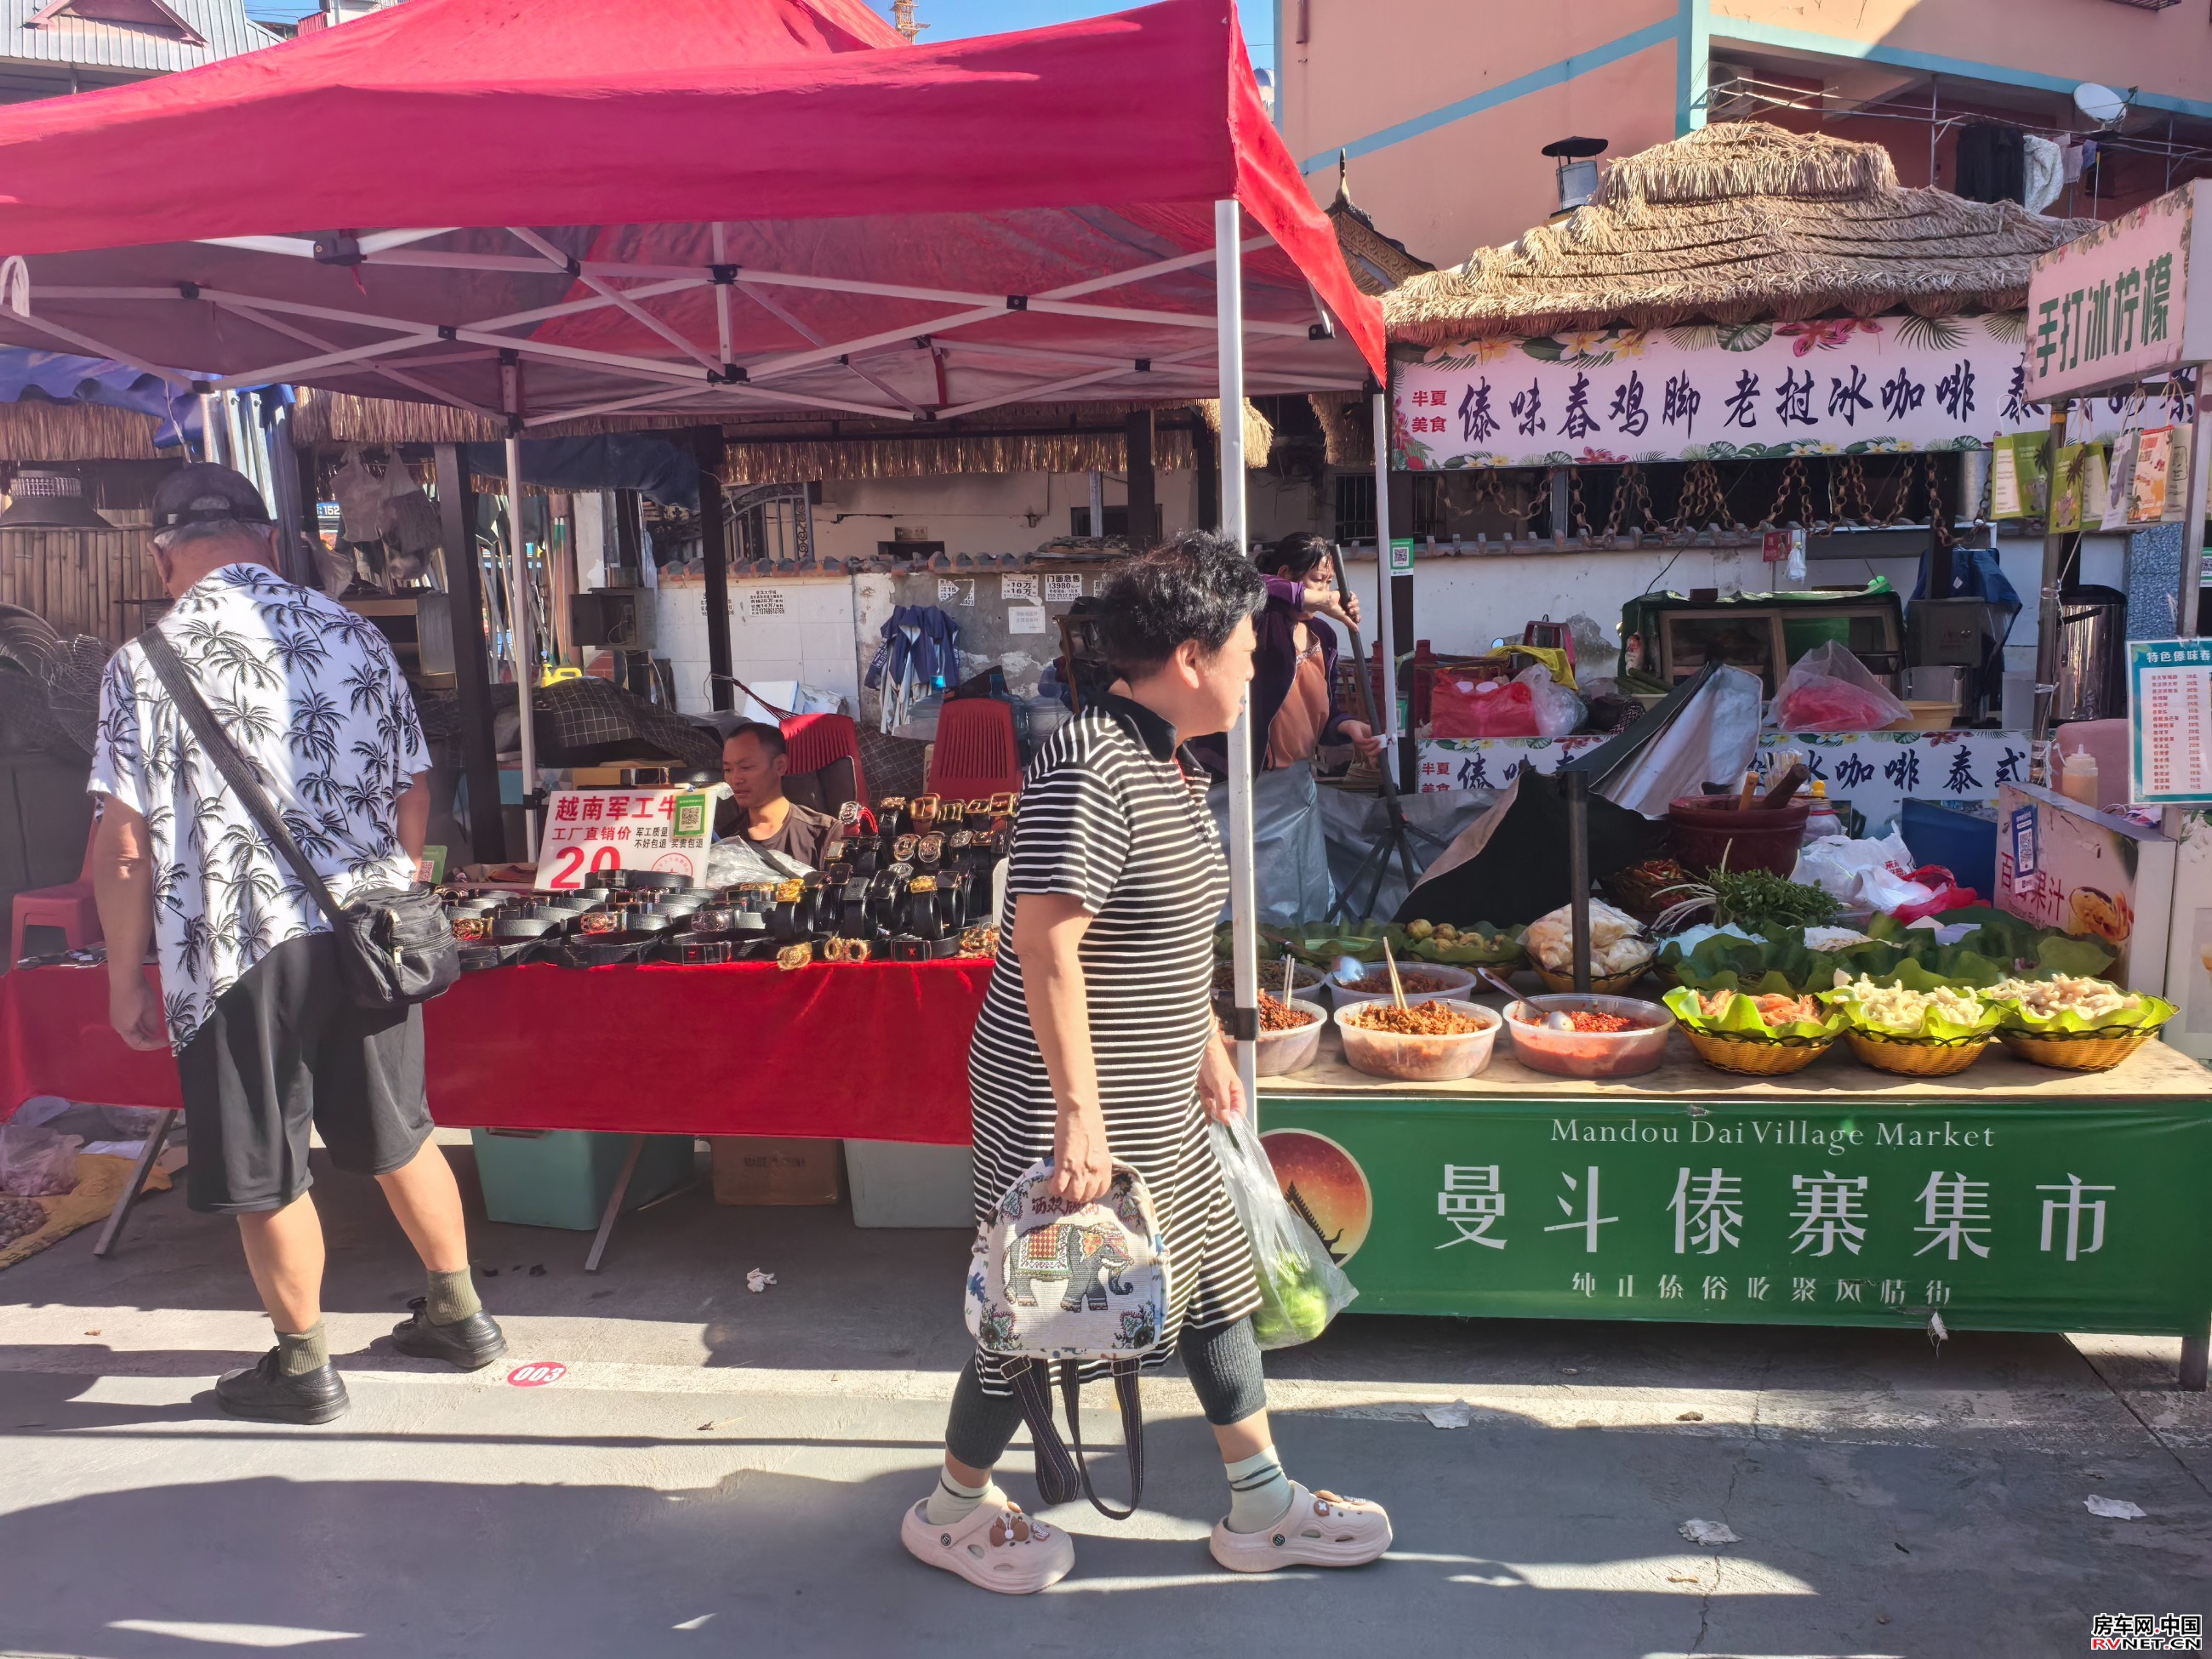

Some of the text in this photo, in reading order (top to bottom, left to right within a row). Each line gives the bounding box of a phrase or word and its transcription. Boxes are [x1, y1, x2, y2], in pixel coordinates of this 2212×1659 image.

[2036, 251, 2173, 379] 手打冰柠檬
[1411, 390, 1448, 407] 半夏
[1723, 358, 1975, 428] 老挝冰咖啡
[1411, 416, 1448, 433] 美食
[1046, 574, 1080, 583] 门面急售
[1421, 762, 1451, 775] 半夏
[551, 826, 632, 841] 工厂直销价
[635, 826, 669, 837] 军工质量
[634, 838, 667, 849] 不好包退
[550, 845, 621, 889] 20
[2000, 851, 2065, 921] 百果汁
[1550, 1118, 1996, 1156] Mandou Dai Village Market
[1434, 1163, 2117, 1262] 曼斗傣寨集市
[512, 1366, 566, 1382] 003
